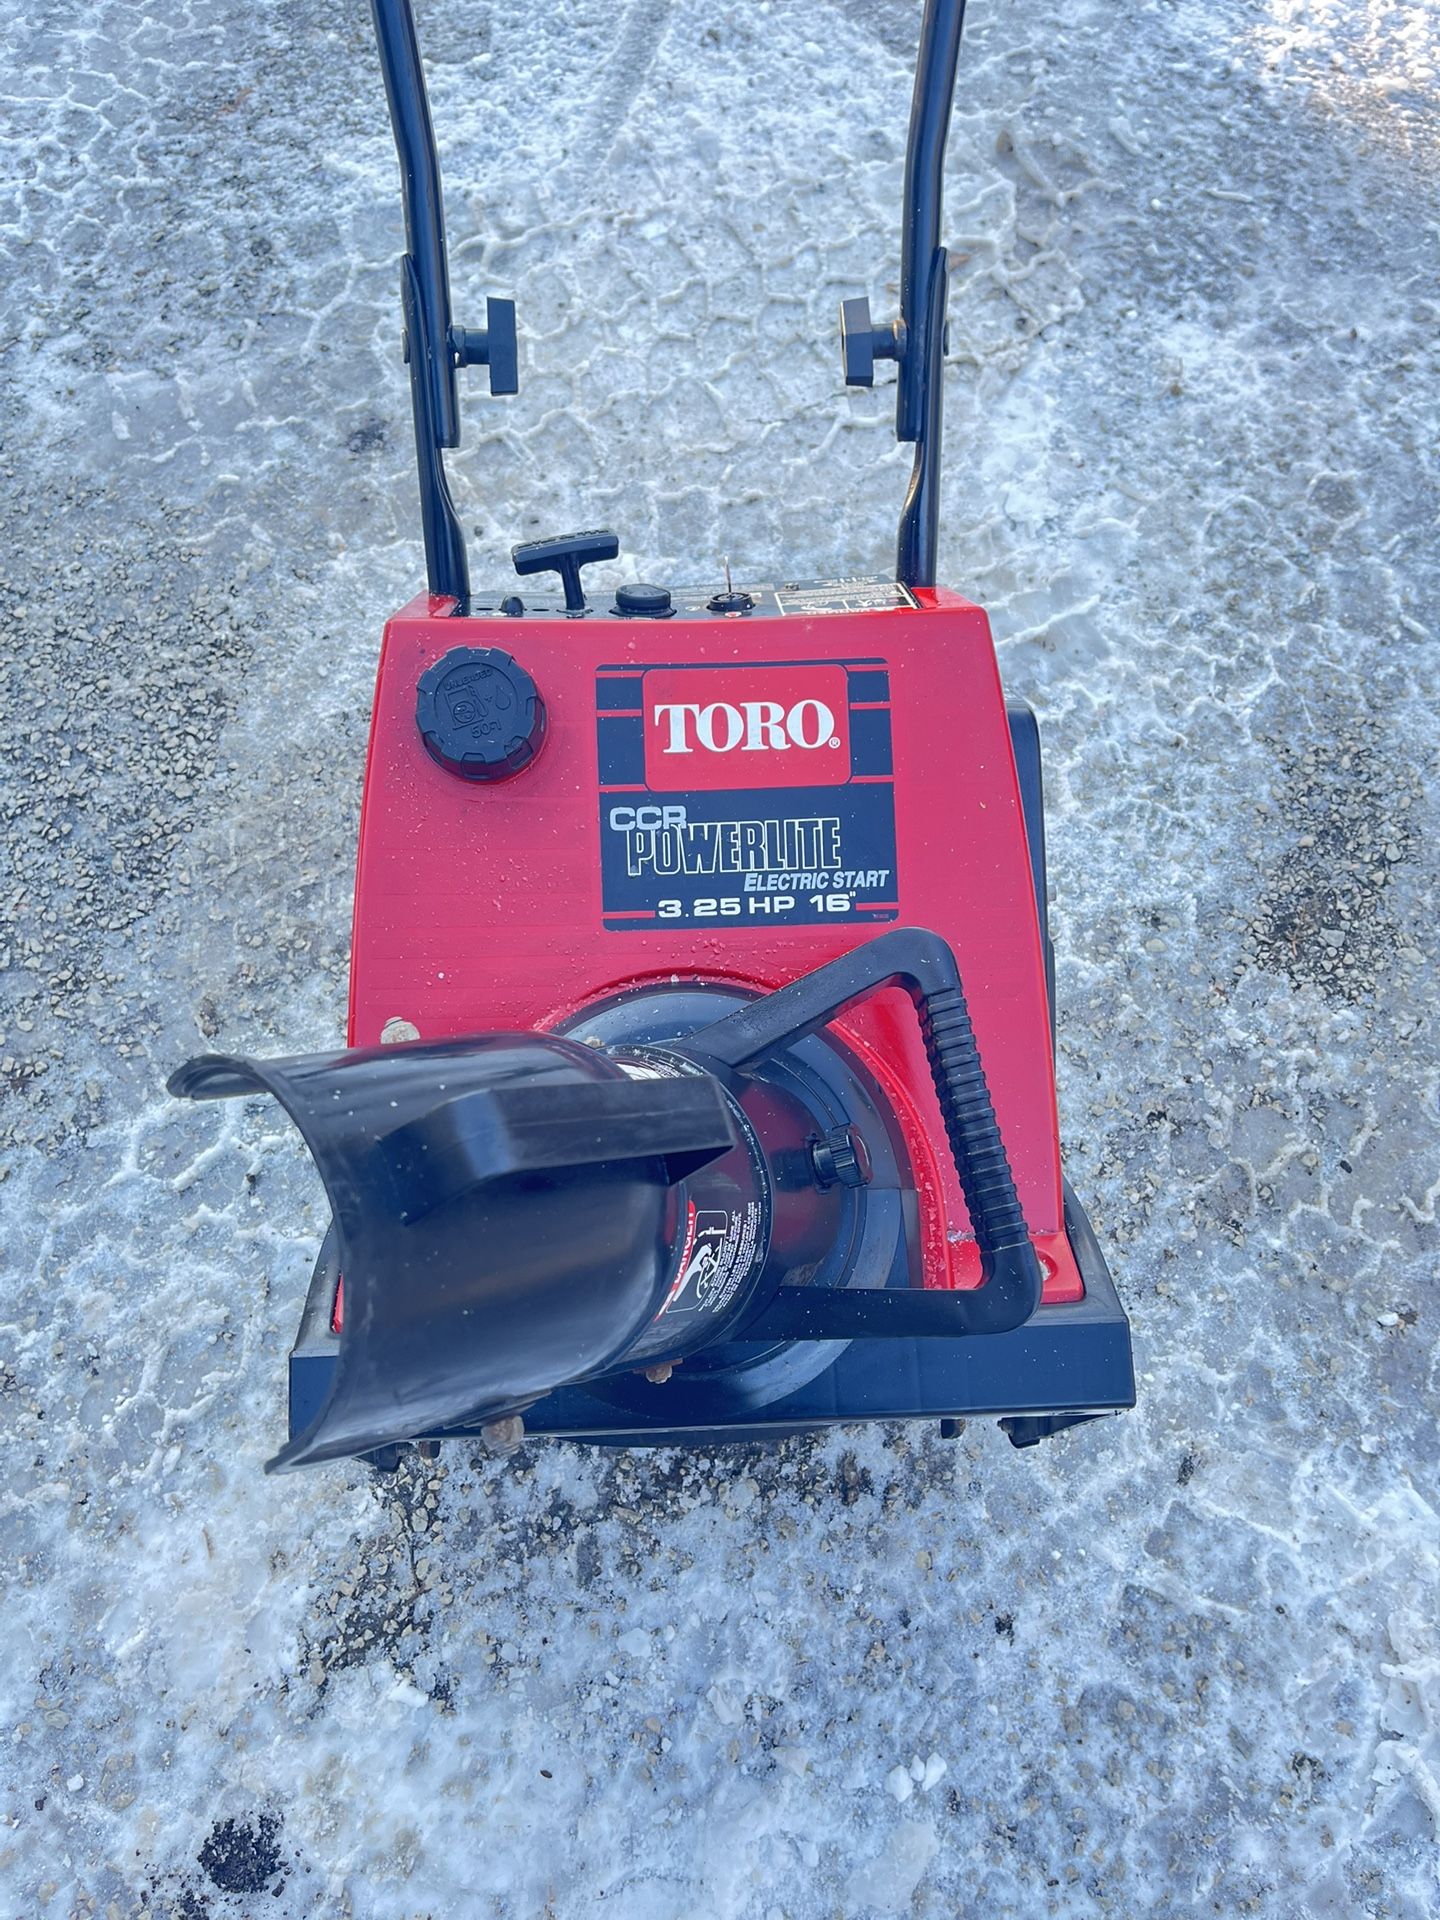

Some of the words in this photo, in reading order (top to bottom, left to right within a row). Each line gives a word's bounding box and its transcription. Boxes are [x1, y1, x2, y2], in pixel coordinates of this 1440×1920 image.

[609, 805, 687, 831] CCR
[626, 816, 842, 878] POWERLITE
[743, 872, 829, 892] ELECTRIC
[832, 869, 890, 889] START
[749, 895, 796, 914] HP
